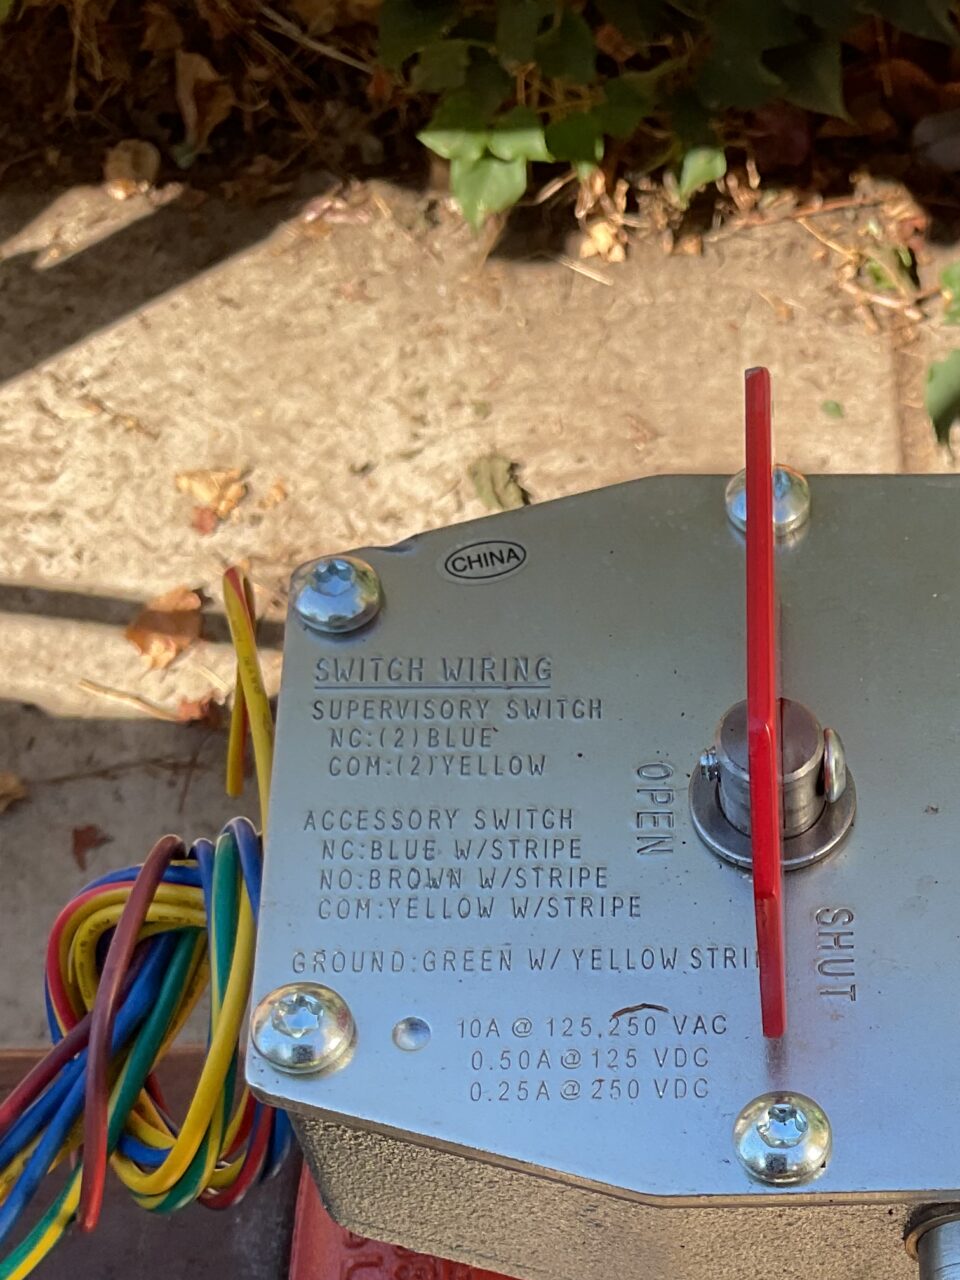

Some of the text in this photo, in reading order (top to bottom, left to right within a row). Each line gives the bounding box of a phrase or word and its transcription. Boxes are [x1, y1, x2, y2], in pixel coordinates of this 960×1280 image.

[450, 545, 522, 573] CHINA
[314, 656, 553, 683] SWITCH WIRING
[311, 698, 602, 721] SUPERVISORY SWITCH
[329, 727, 494, 749] NC:(2)BLUE
[328, 753, 547, 778] COM:(2)YELLOW
[303, 808, 574, 832] ACCESSORY SWITCH
[636, 761, 674, 855] OPEN
[321, 838, 583, 861] NC:BLUE W/STRIPE
[319, 866, 609, 891] NO:BROWN W/STRIPE
[317, 896, 642, 920] COM:YELLOW W/STRIPE
[292, 949, 514, 974] GROUND:GREEN
[572, 948, 679, 971] YELLOW
[690, 947, 760, 970] STRI
[815, 907, 857, 1002] SHUT
[457, 1018, 501, 1040] 10A
[511, 1017, 535, 1038] @
[673, 1015, 729, 1037] VAC
[470, 1049, 552, 1071] 0.50A
[591, 1048, 640, 1069] 125
[653, 1046, 711, 1068] VDC
[469, 1080, 551, 1103] 0.25A
[590, 1078, 641, 1100] 250
[656, 1077, 711, 1099] VDC
